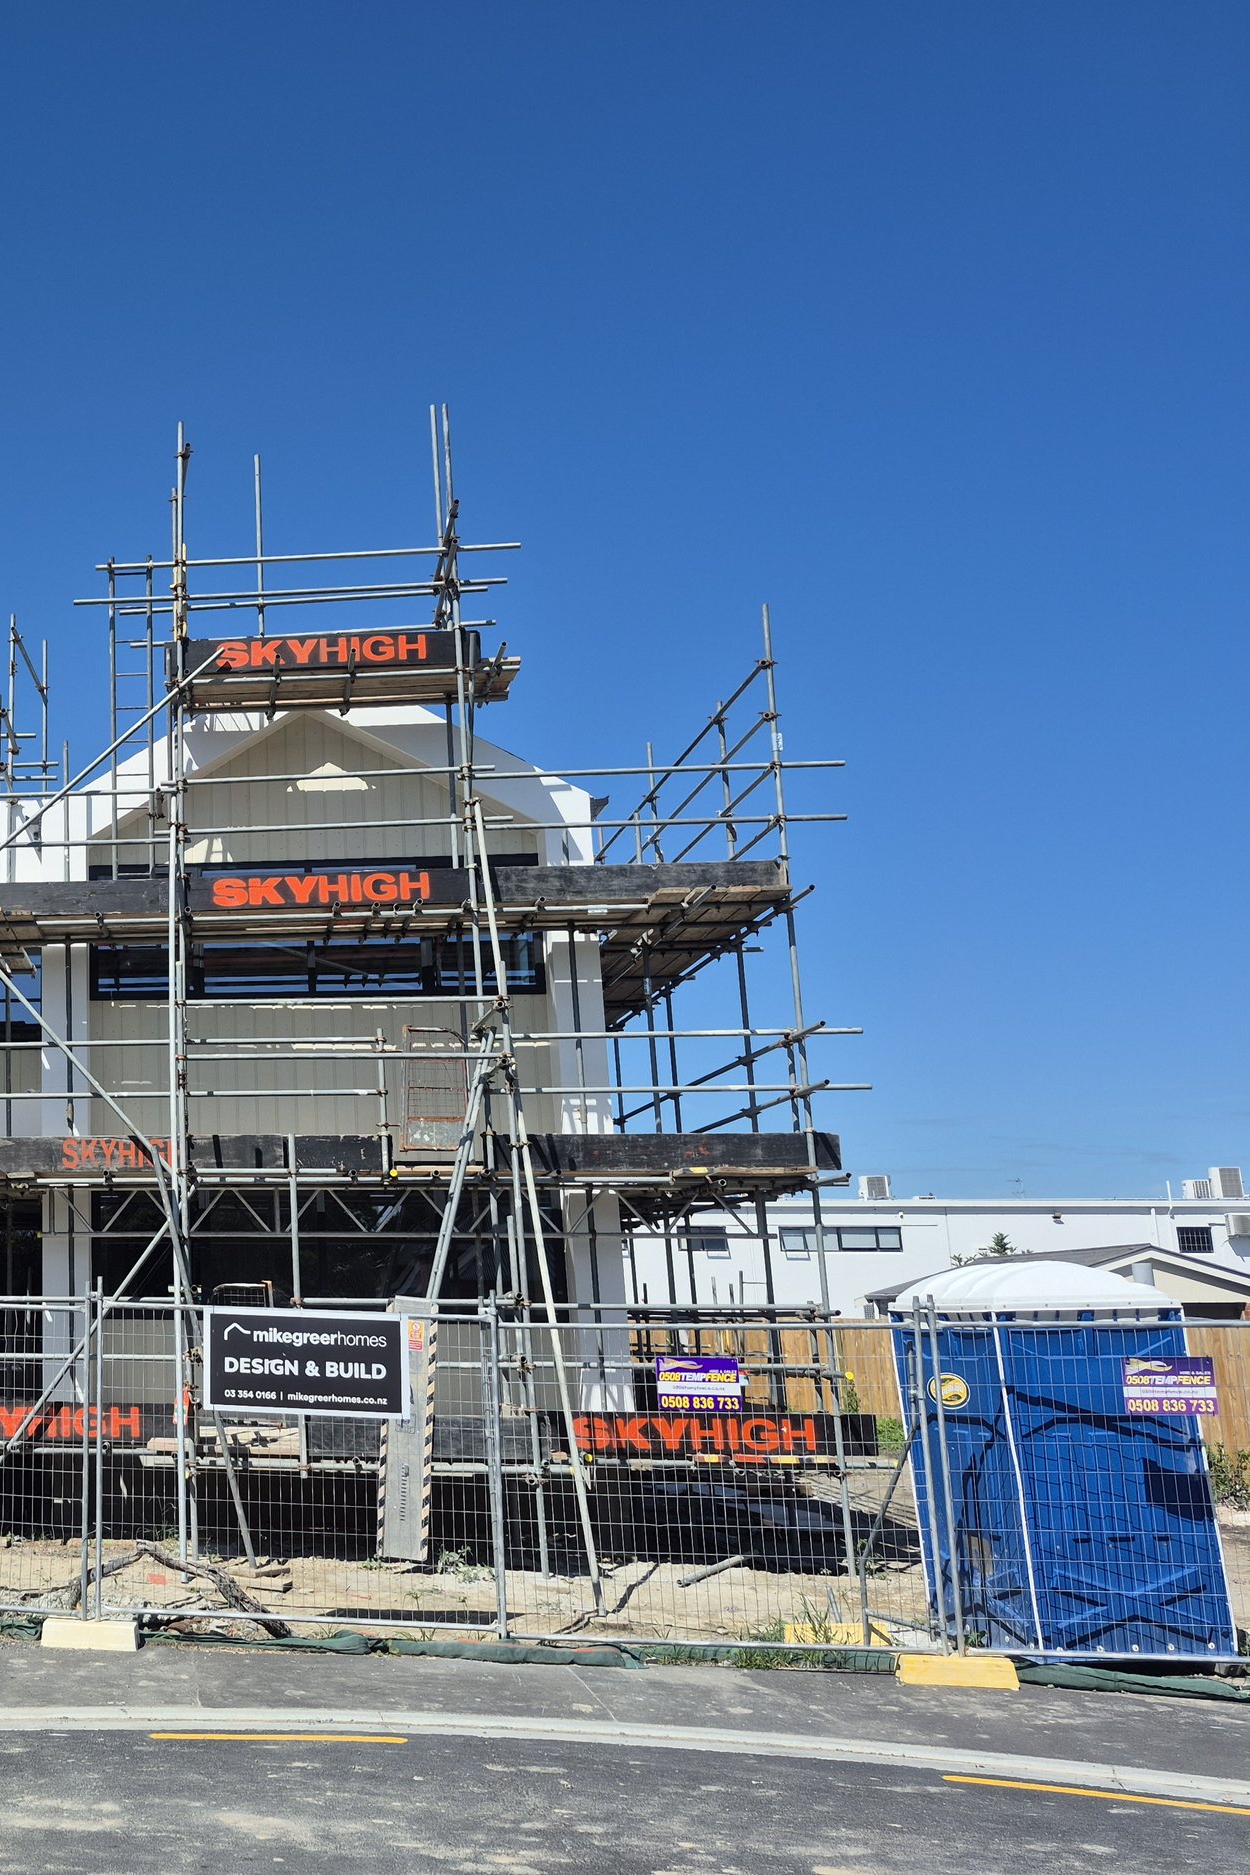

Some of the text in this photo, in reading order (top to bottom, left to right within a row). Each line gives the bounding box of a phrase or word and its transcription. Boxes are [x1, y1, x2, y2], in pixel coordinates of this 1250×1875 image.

[216, 634, 427, 668] SKYHIGH
[213, 872, 430, 907] SKYHIGH
[253, 1328, 387, 1348] mikegreerhomes
[224, 1356, 387, 1380] DESIGN & BUILD
[659, 1372, 737, 1382] 0508TEMPFENCE
[1126, 1376, 1212, 1384] 0508TEMPFENCE
[224, 1390, 388, 1405] 03 354 0166 mikegreerhomes.co.nz
[661, 1396, 739, 1410] 0508 836 733
[1128, 1400, 1214, 1412] 0508 836 733
[573, 1418, 816, 1450] SKYHIGH
